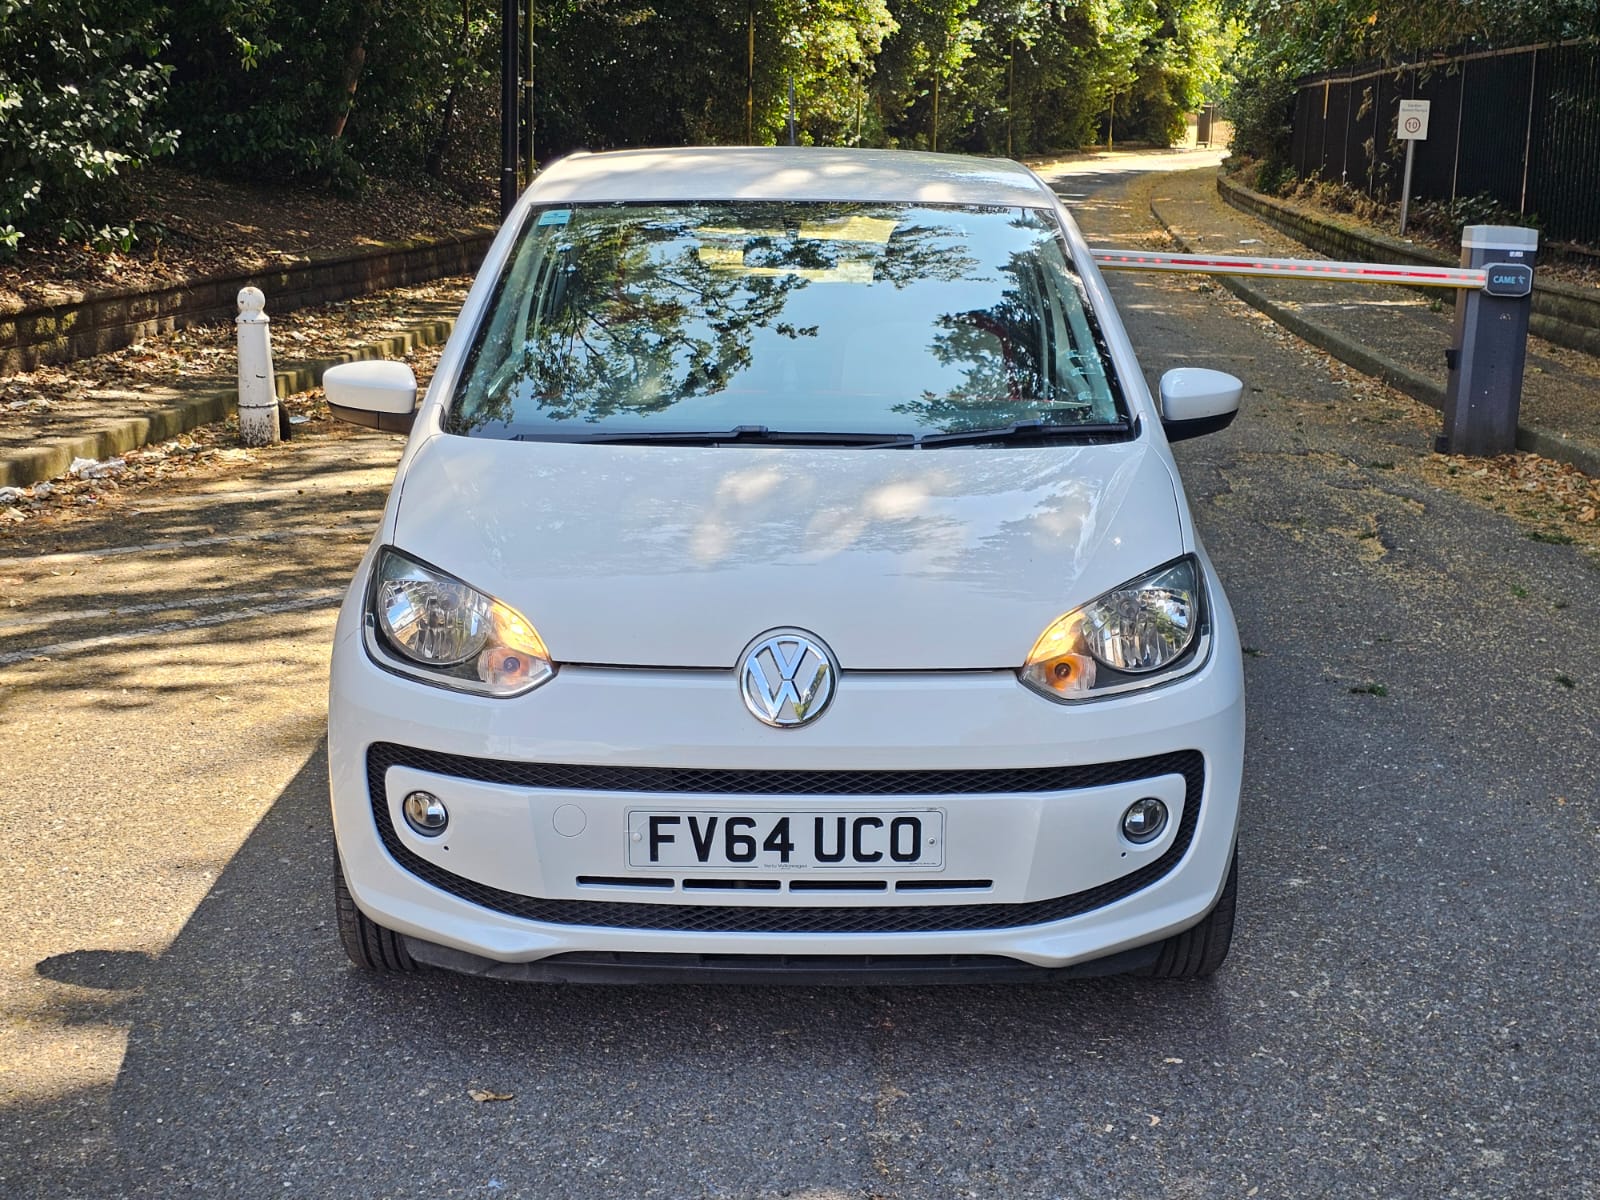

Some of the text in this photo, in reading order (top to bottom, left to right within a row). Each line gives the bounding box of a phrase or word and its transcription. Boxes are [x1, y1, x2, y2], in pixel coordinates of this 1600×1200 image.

[1407, 121, 1418, 130] 10
[1493, 275, 1516, 284] CAME
[648, 816, 922, 864] FV64 UCO
